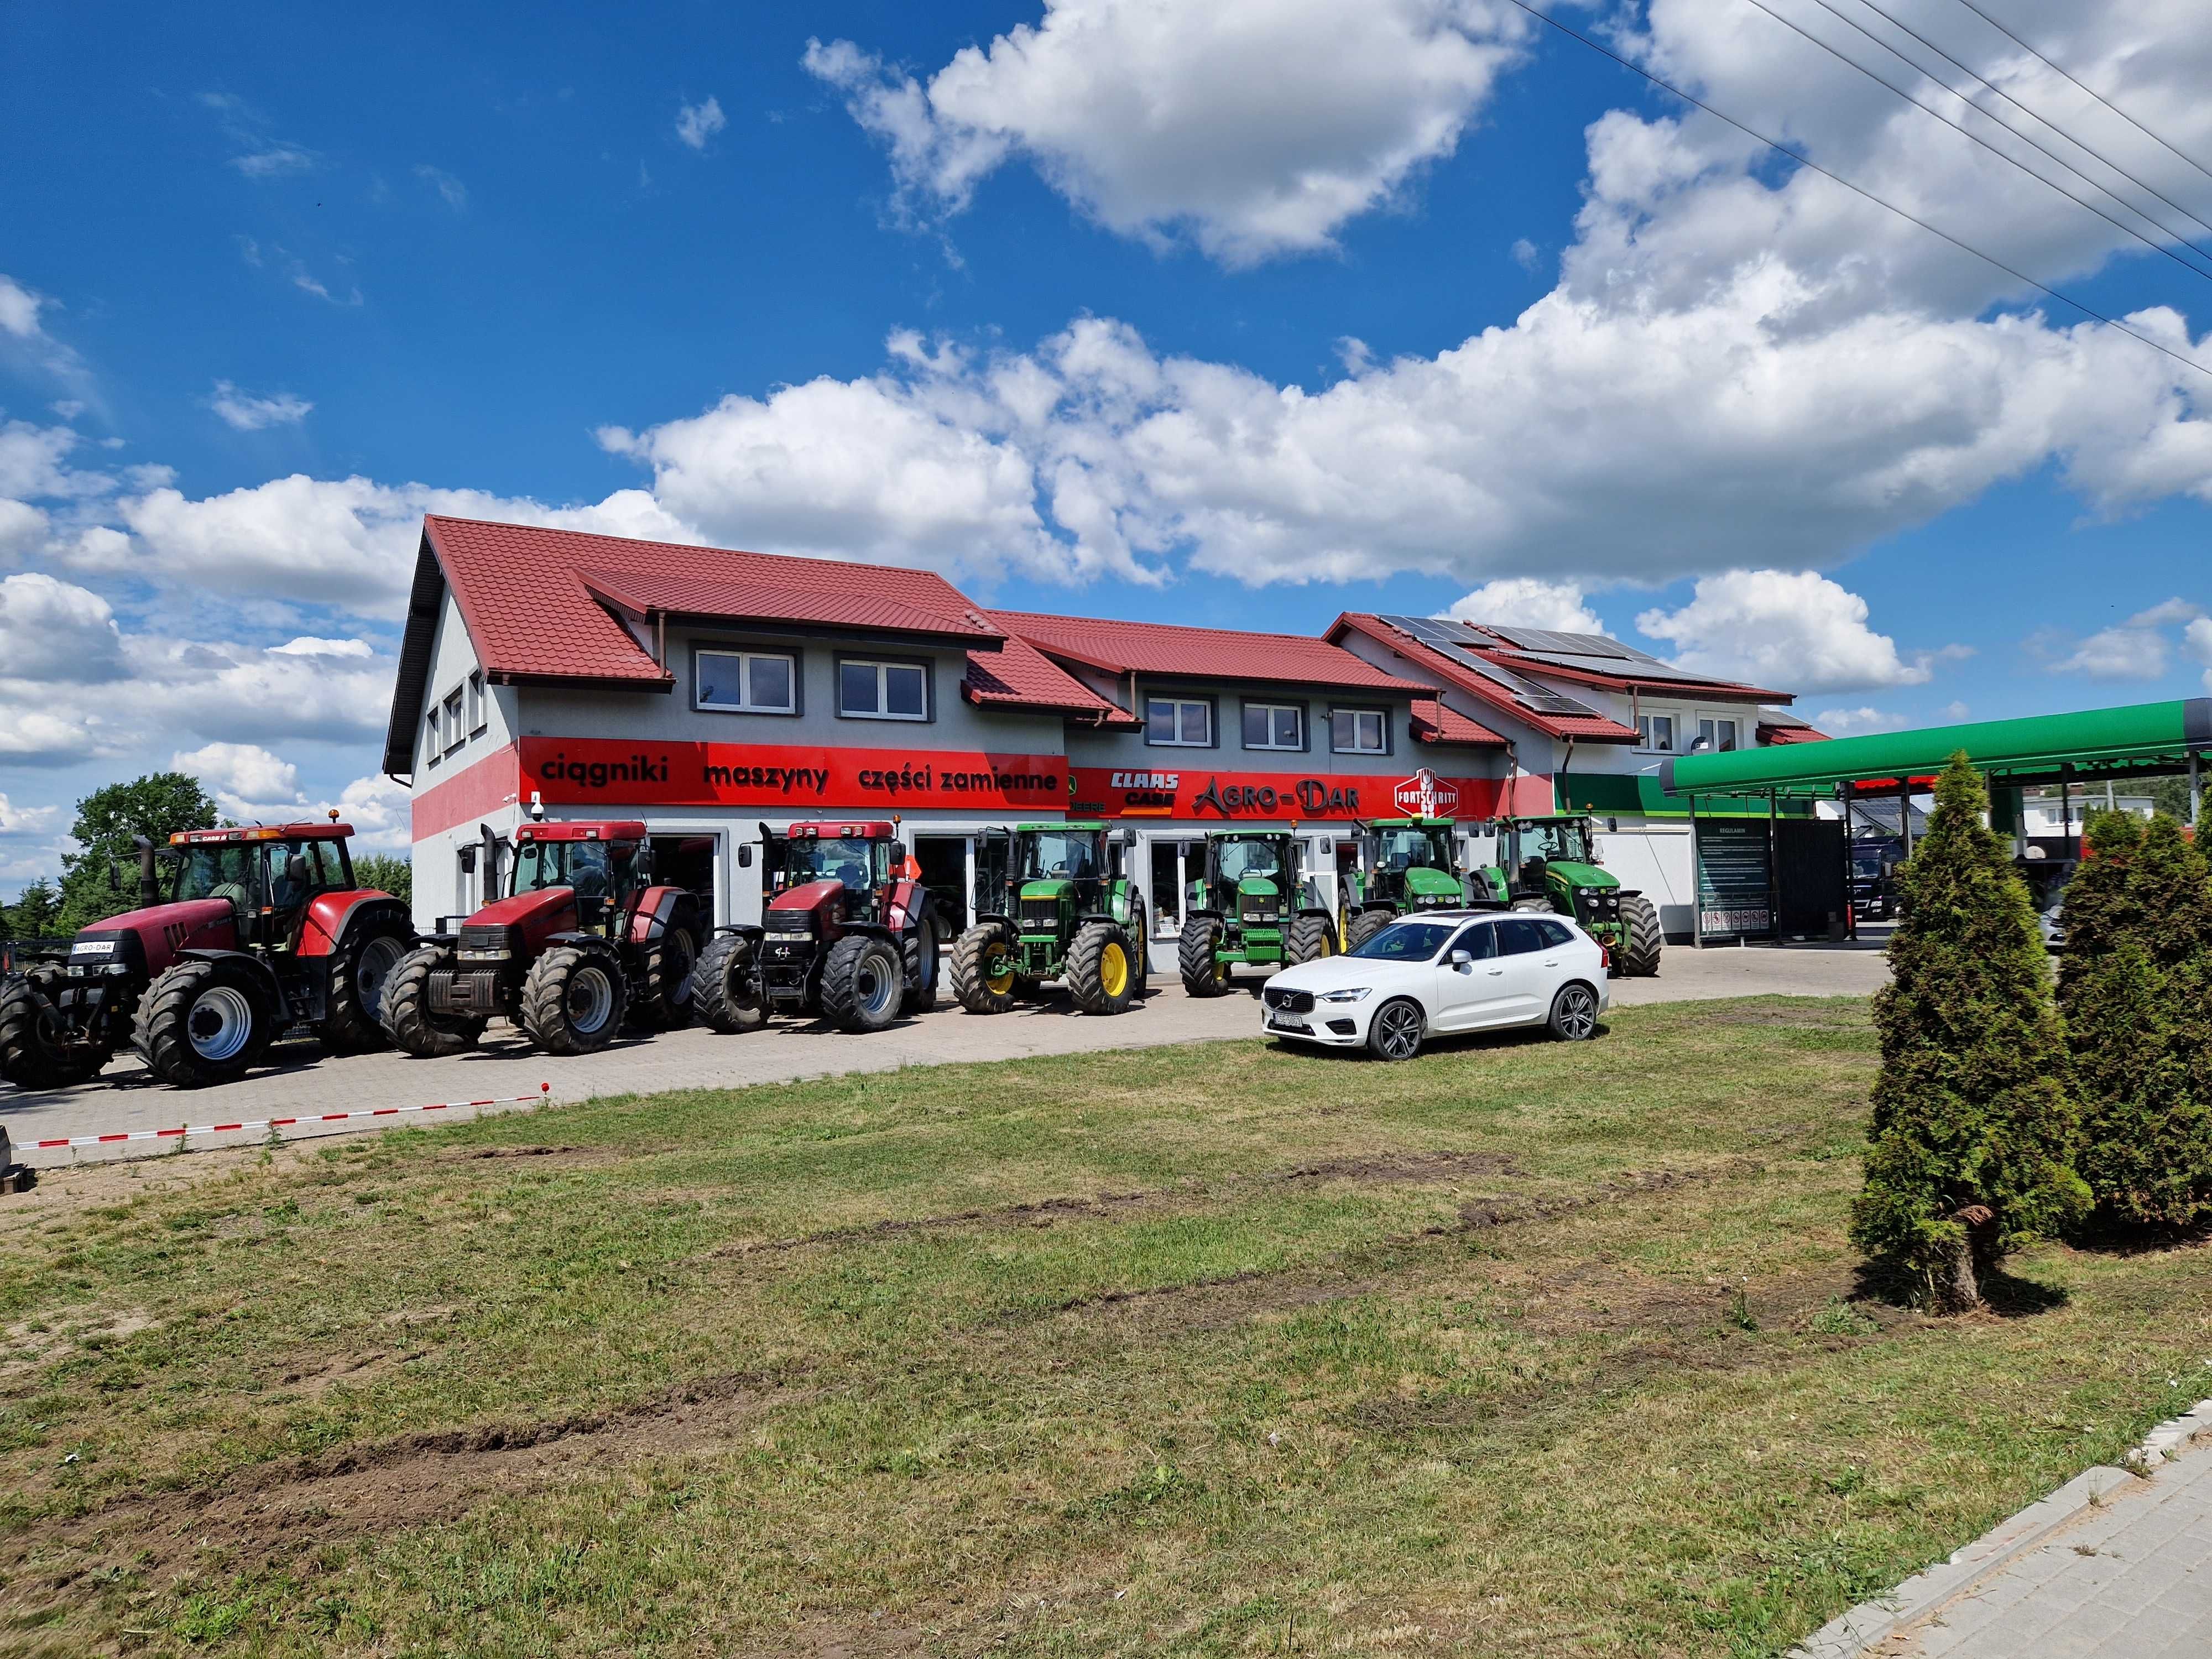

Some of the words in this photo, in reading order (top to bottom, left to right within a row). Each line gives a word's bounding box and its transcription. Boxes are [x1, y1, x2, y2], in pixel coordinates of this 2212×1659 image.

[540, 753, 669, 788] ciągniki
[703, 764, 830, 795] maszyny
[858, 761, 932, 795] części
[940, 766, 1058, 791] zamienne
[1111, 772, 1179, 789] CLAAS
[1125, 791, 1177, 806] CASE
[1398, 791, 1456, 805] FORTSCHRITT
